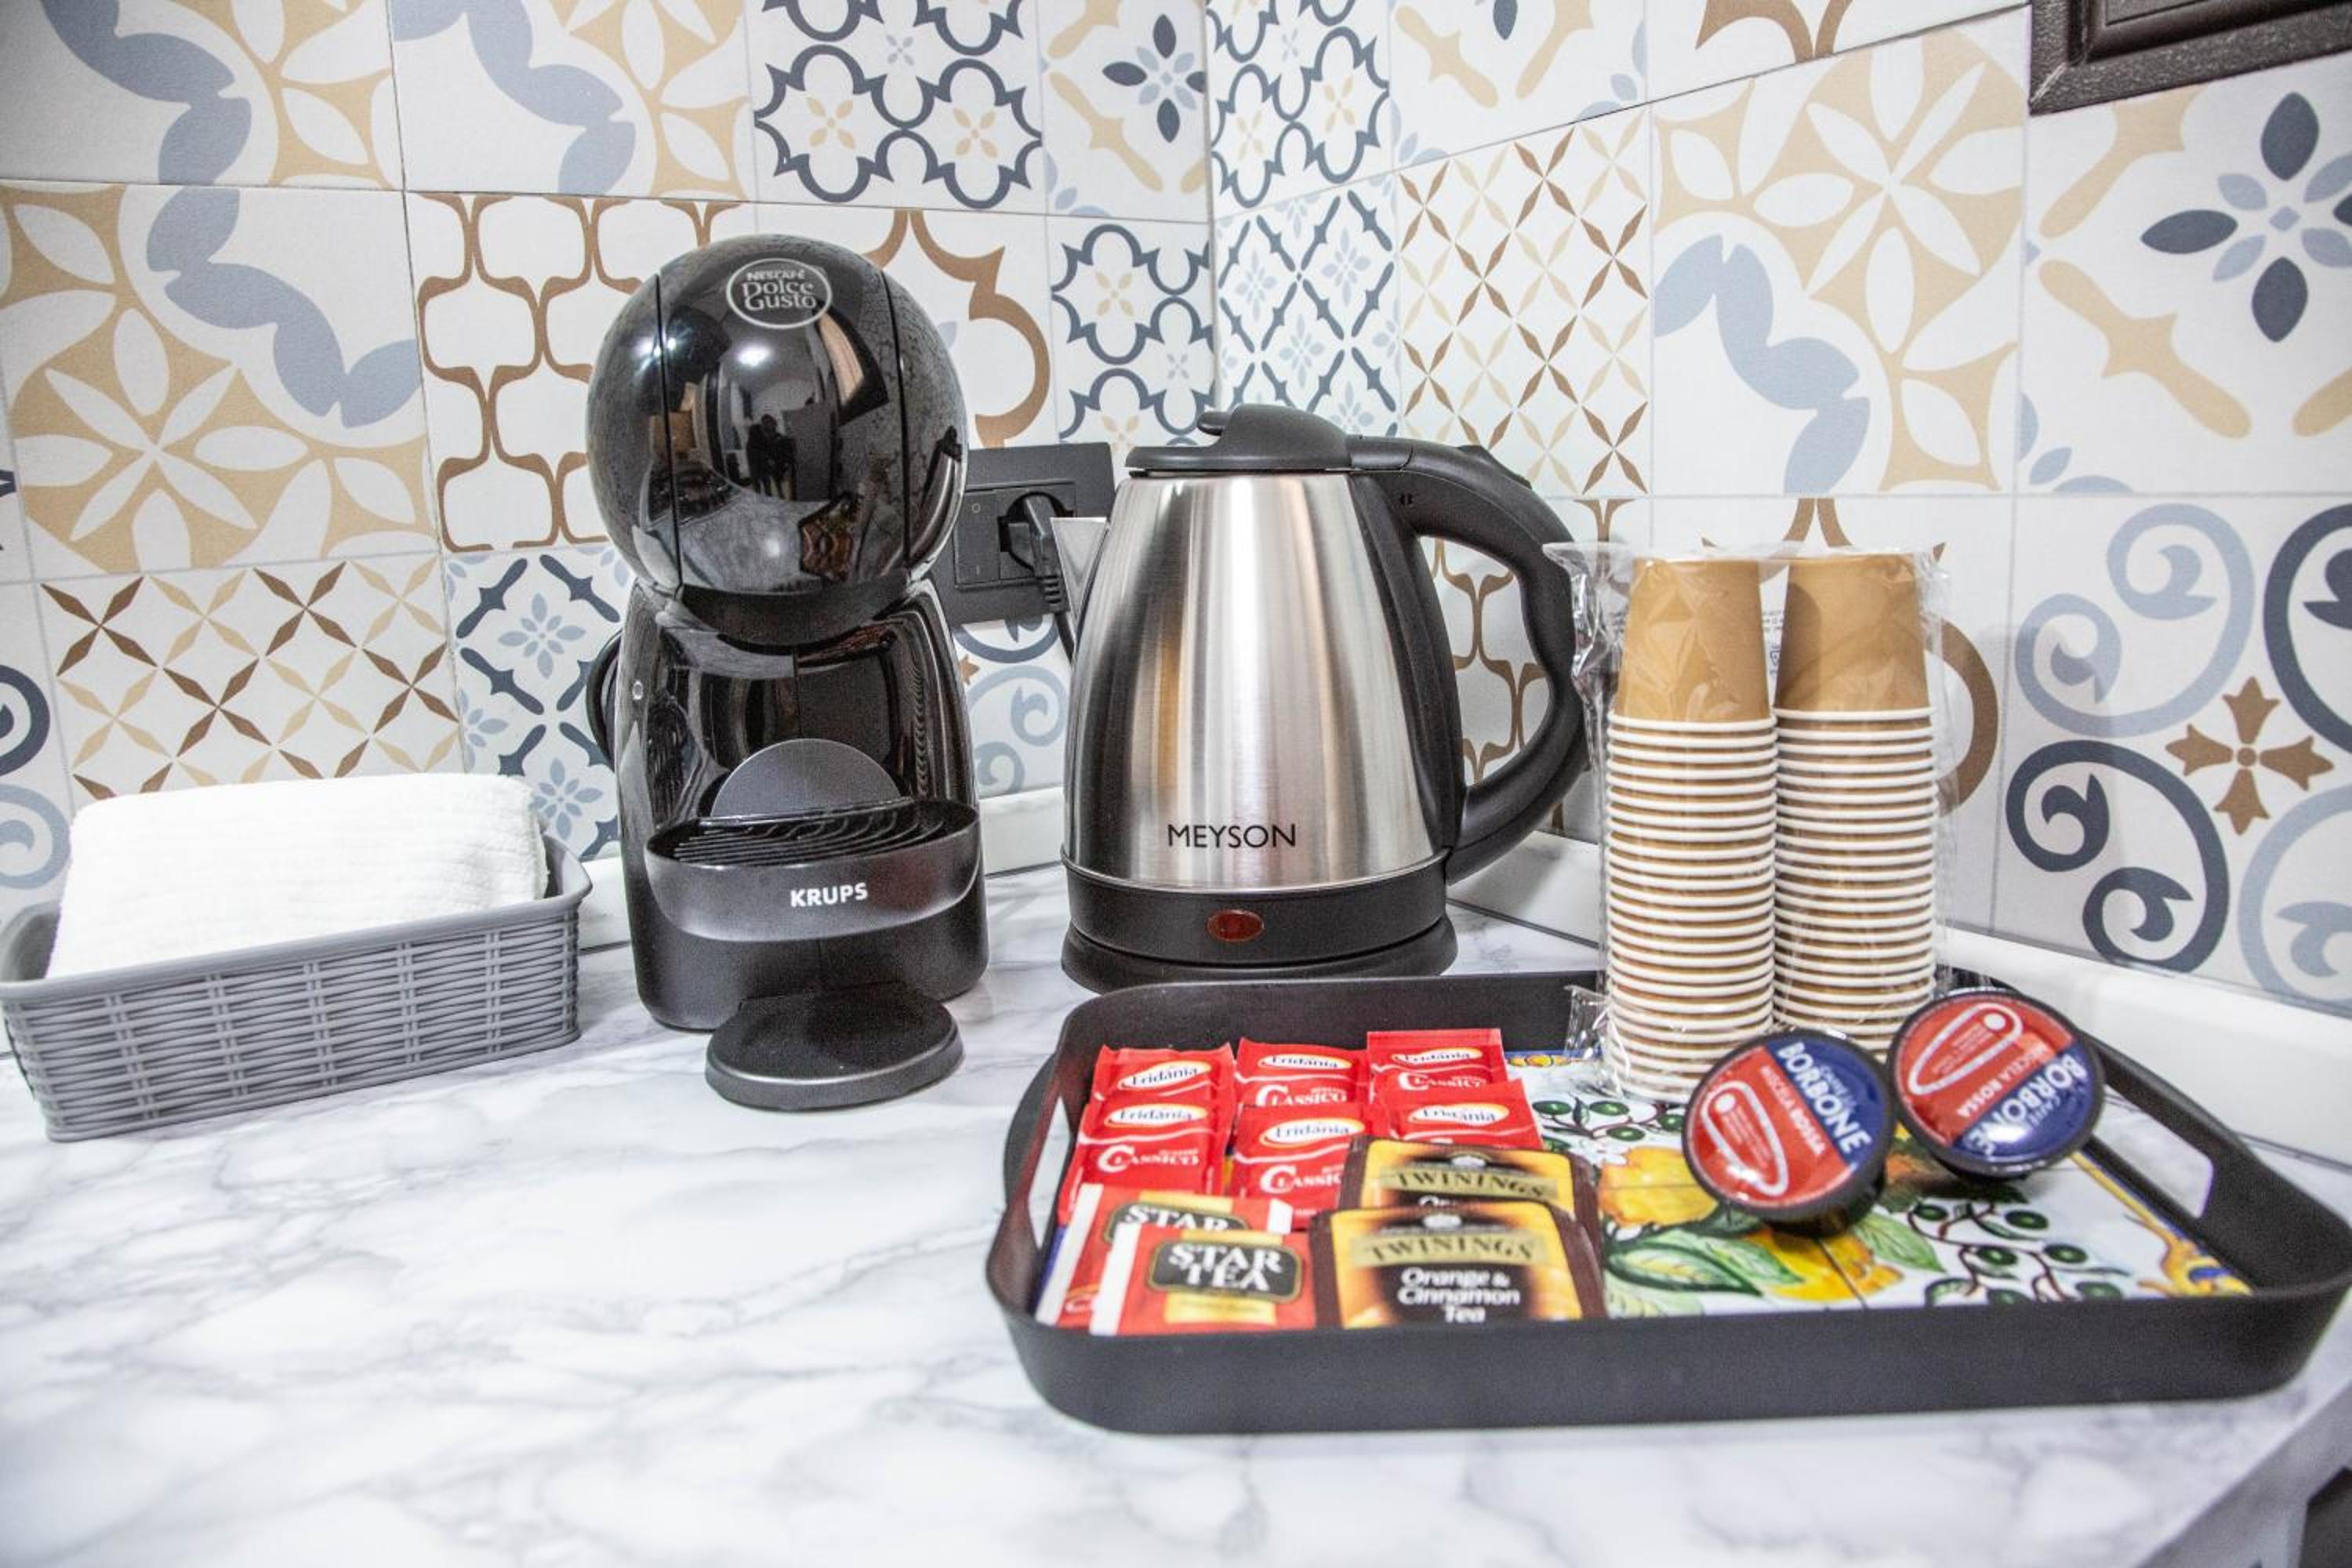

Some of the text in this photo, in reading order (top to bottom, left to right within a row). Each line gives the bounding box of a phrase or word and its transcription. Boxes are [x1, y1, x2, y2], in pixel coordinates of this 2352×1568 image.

[742, 279, 815, 298] Dolce
[744, 292, 817, 311] Gusto
[1167, 823, 1296, 848] MEYSON
[790, 882, 868, 907] KRUPS
[1777, 1040, 1872, 1155] BORBONE
[1956, 1076, 2002, 1118] ROSSA
[1967, 1052, 2088, 1156] BORBONE
[1397, 1171, 1548, 1197] TWININGS
[1169, 1243, 1283, 1272] STAR
[1367, 1236, 1535, 1261] TWININGS
[1185, 1262, 1270, 1292] TEA
[1400, 1267, 1490, 1287] Orange
[1397, 1287, 1521, 1305] Cinnamon
[1443, 1305, 1486, 1324] Tea
